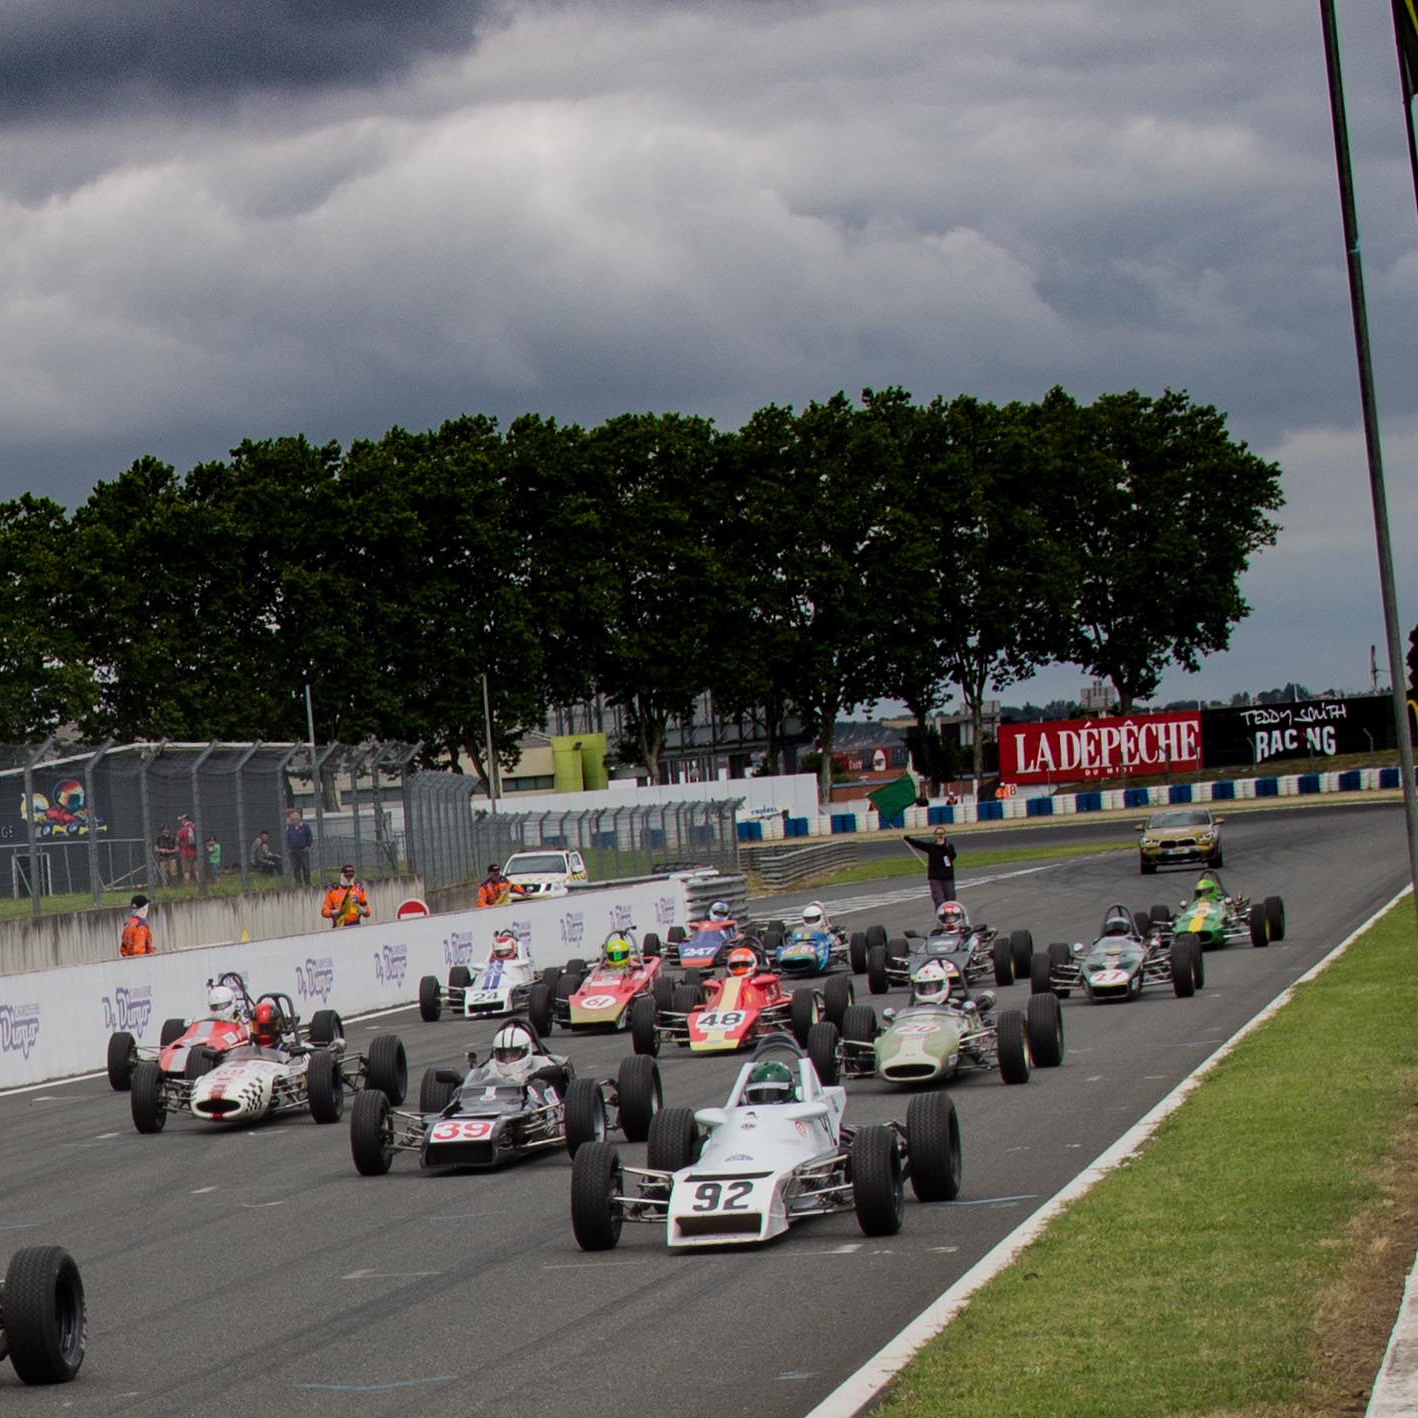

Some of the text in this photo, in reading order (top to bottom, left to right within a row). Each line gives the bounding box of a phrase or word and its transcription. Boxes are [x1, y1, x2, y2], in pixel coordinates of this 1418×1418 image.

[1240, 702, 1347, 727] TEDDY SMITH
[1014, 719, 1201, 775] LA DÉPÊCHE
[682, 946, 715, 957] 247
[472, 991, 498, 1001] 24
[698, 1012, 744, 1027] 48
[433, 1121, 492, 1140] 39
[692, 1181, 754, 1212] 92
